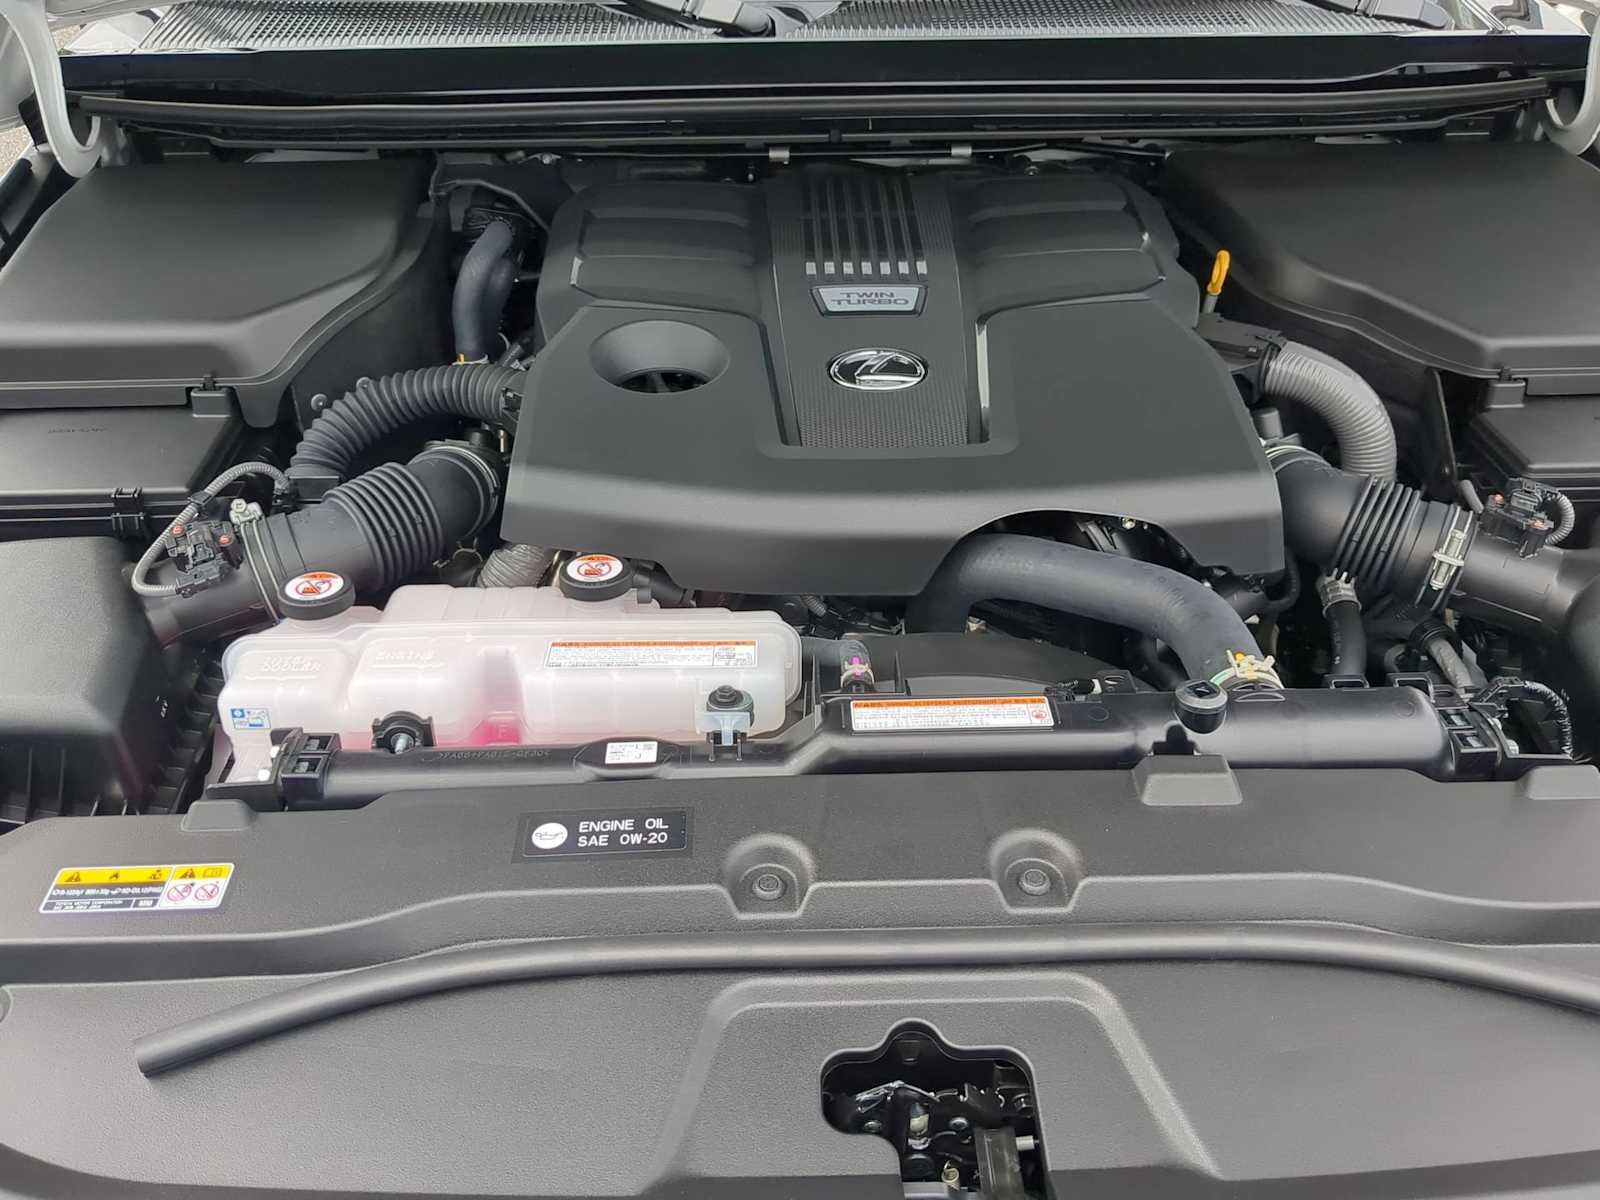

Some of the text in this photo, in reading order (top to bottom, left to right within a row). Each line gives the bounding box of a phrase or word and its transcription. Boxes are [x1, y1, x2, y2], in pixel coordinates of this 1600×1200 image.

[578, 818, 669, 832] ENGINE OIL
[577, 832, 668, 847] SAE 0W-20
